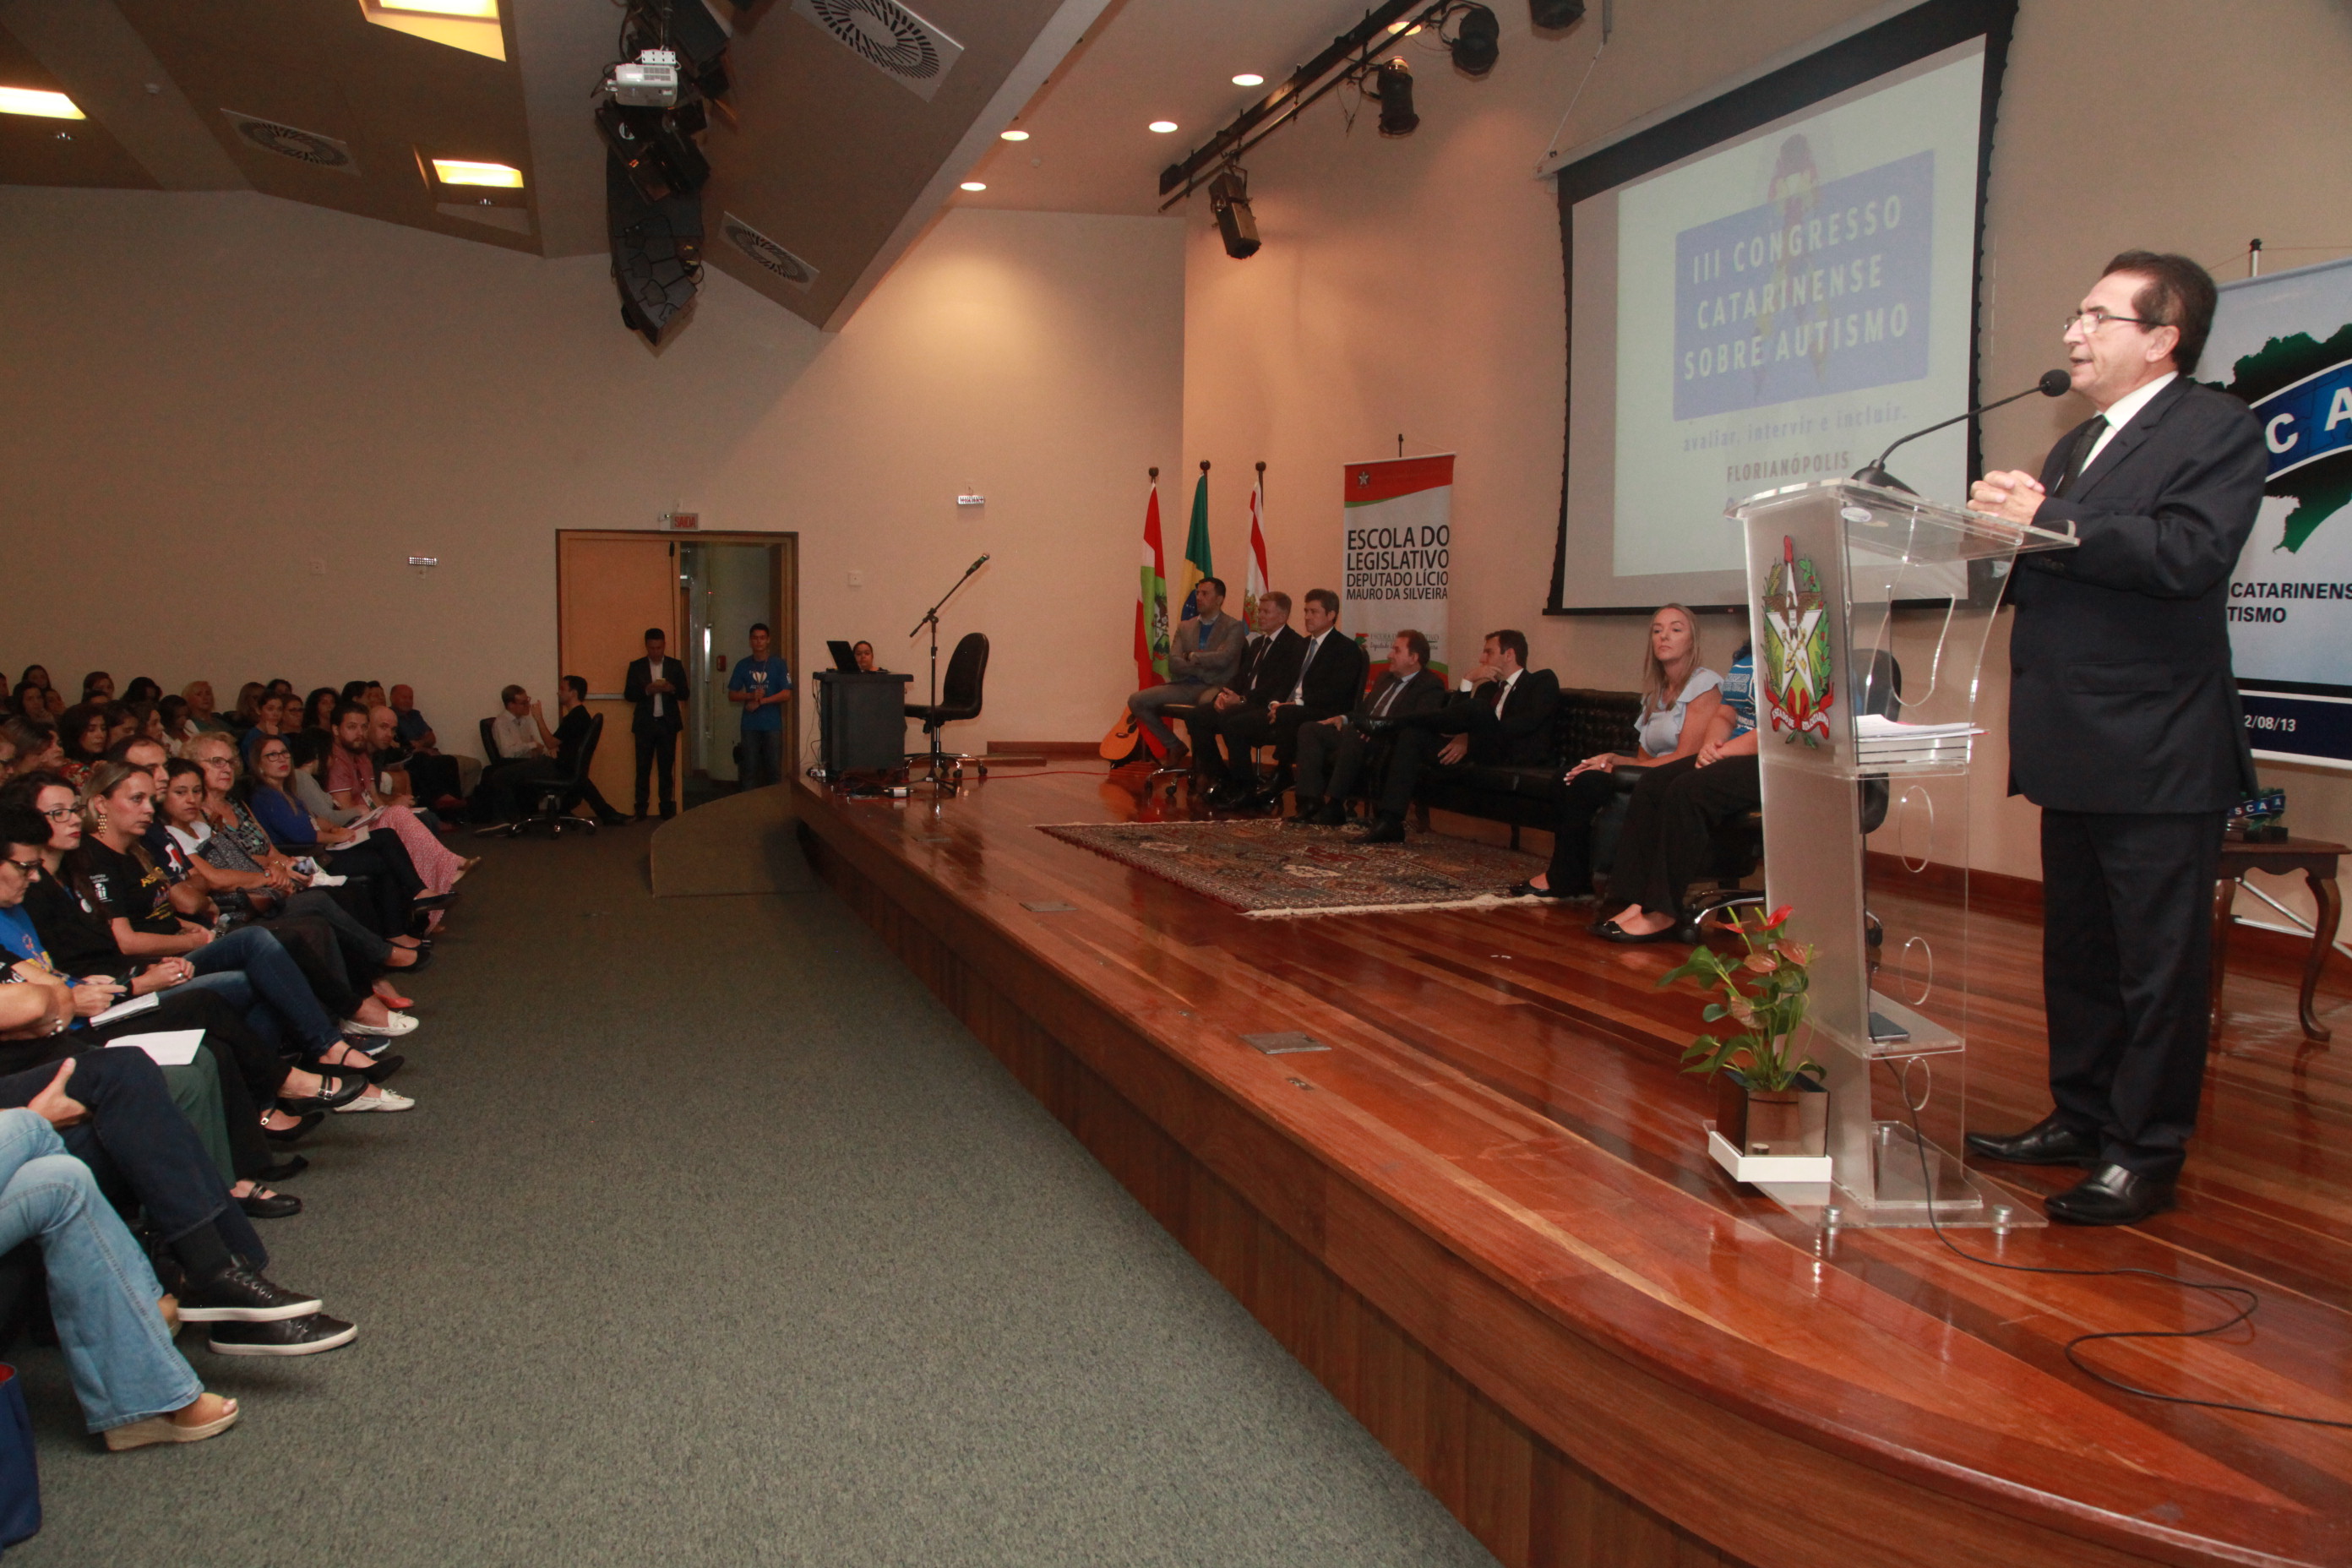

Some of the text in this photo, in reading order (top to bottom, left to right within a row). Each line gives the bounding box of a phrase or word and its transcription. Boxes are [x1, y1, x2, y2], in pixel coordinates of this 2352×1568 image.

[1693, 195, 1901, 285] III CONGRESSO
[1697, 254, 1882, 329] CATARINENSE
[1684, 302, 1908, 381] SOBRE AUTISMO
[1748, 415, 1813, 442] intervir
[1820, 416, 1828, 431] e
[1727, 450, 1850, 483] FLORIANÓPOLIS
[1348, 525, 1450, 550] ESCOLA DO
[1347, 549, 1450, 571] LEGISLATIVO
[1347, 569, 1449, 587] DEPUTADO LÍCIO
[1346, 587, 1448, 600] MAURO DA SILVEIRA
